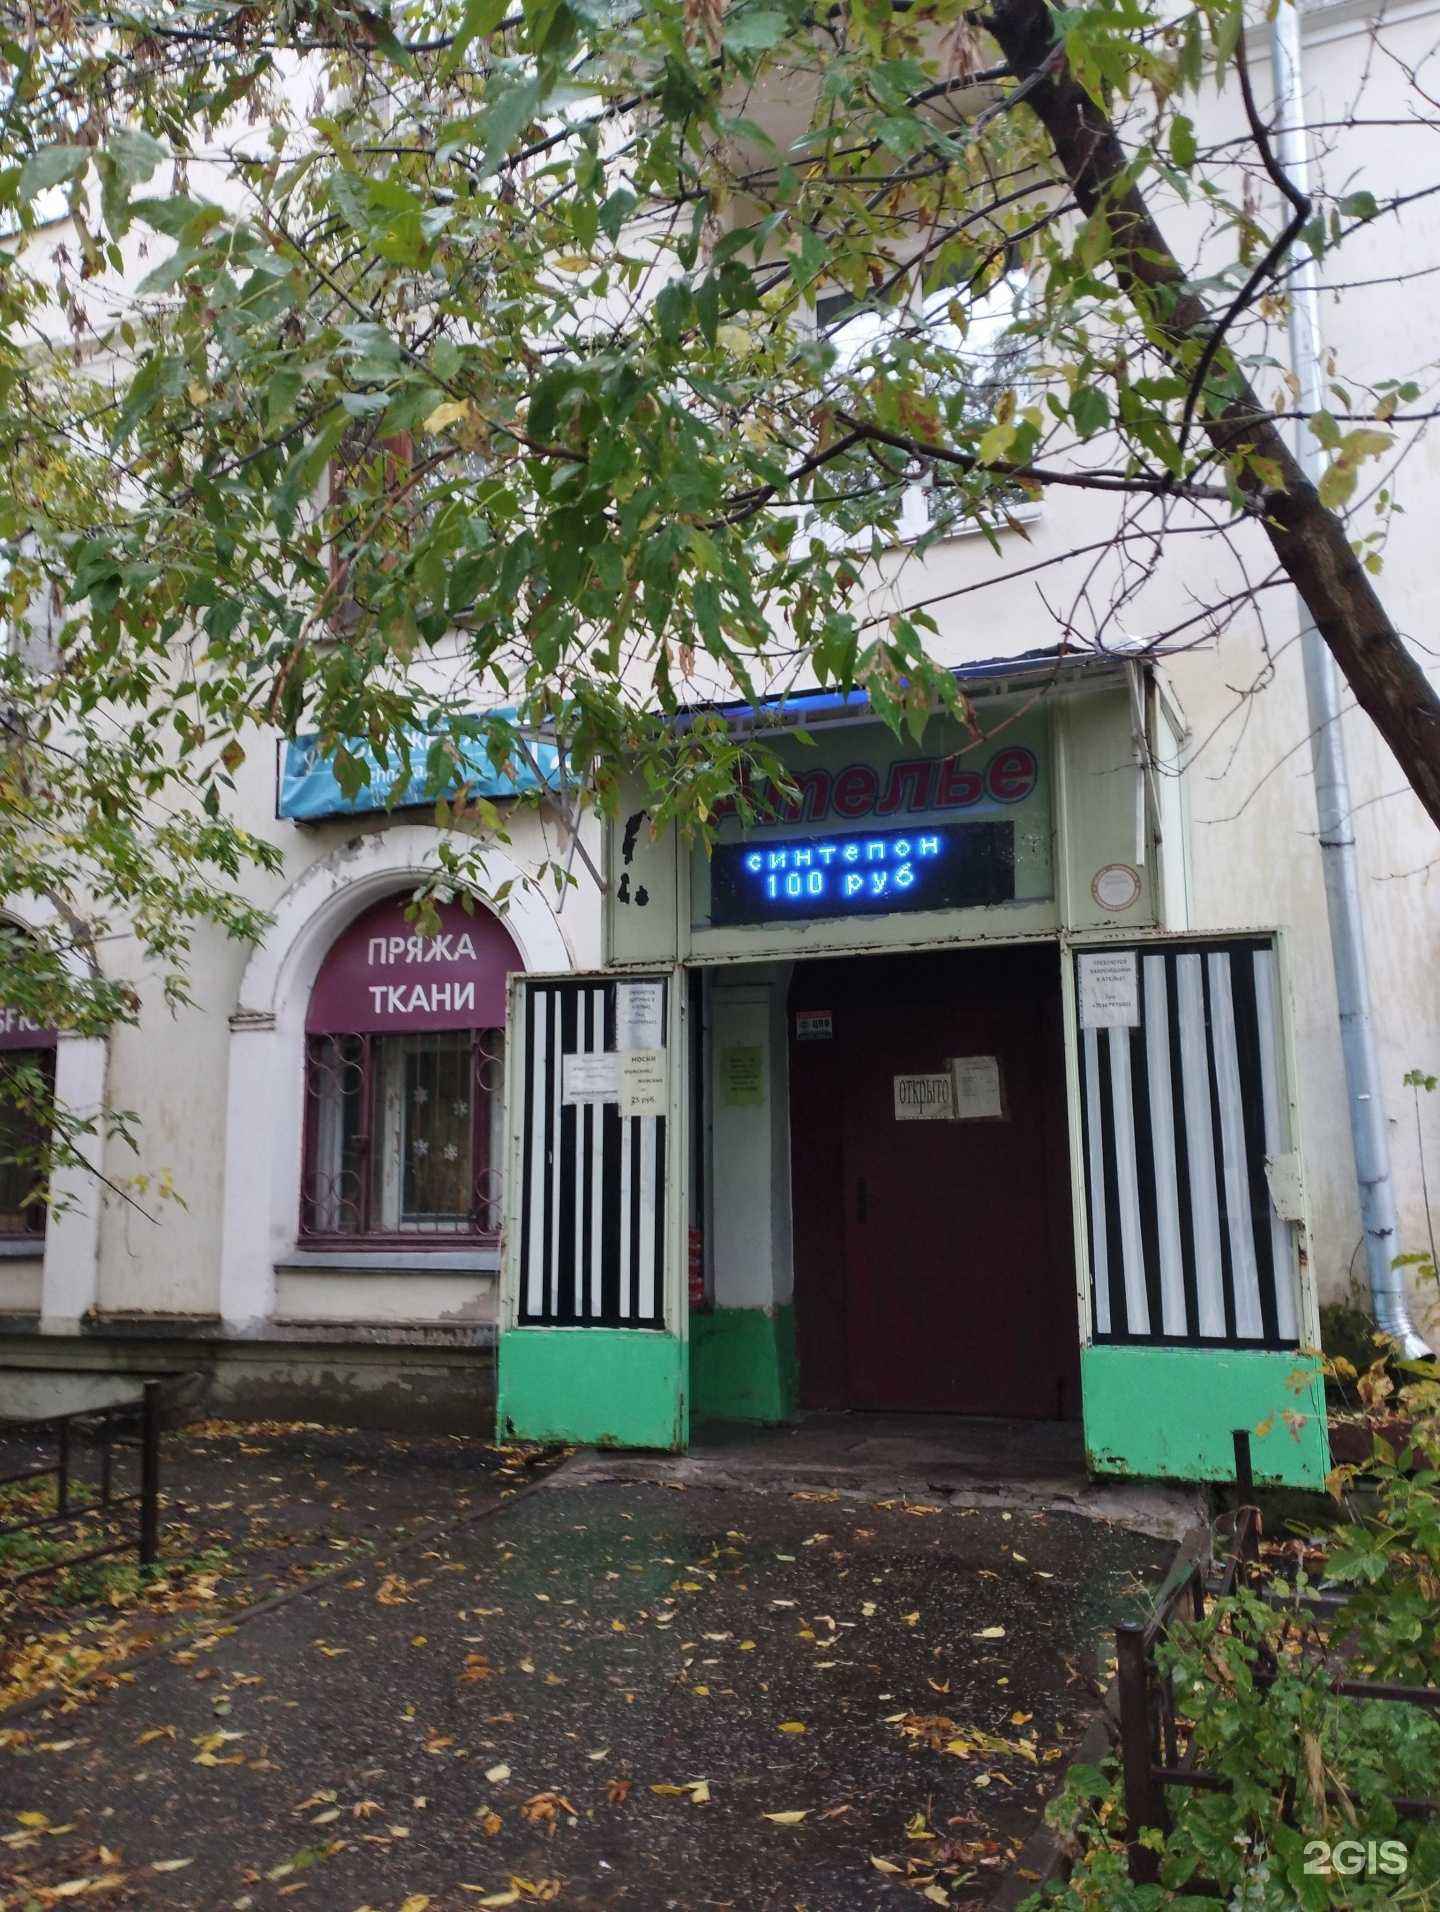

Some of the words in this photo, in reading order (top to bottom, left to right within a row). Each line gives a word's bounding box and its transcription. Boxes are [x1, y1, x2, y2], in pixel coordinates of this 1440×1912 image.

[746, 836, 940, 871] синтепон
[768, 871, 824, 897] 100
[848, 863, 914, 895] руб
[368, 933, 478, 965] ПРЯЖА
[369, 982, 476, 1014] ТКАНИ
